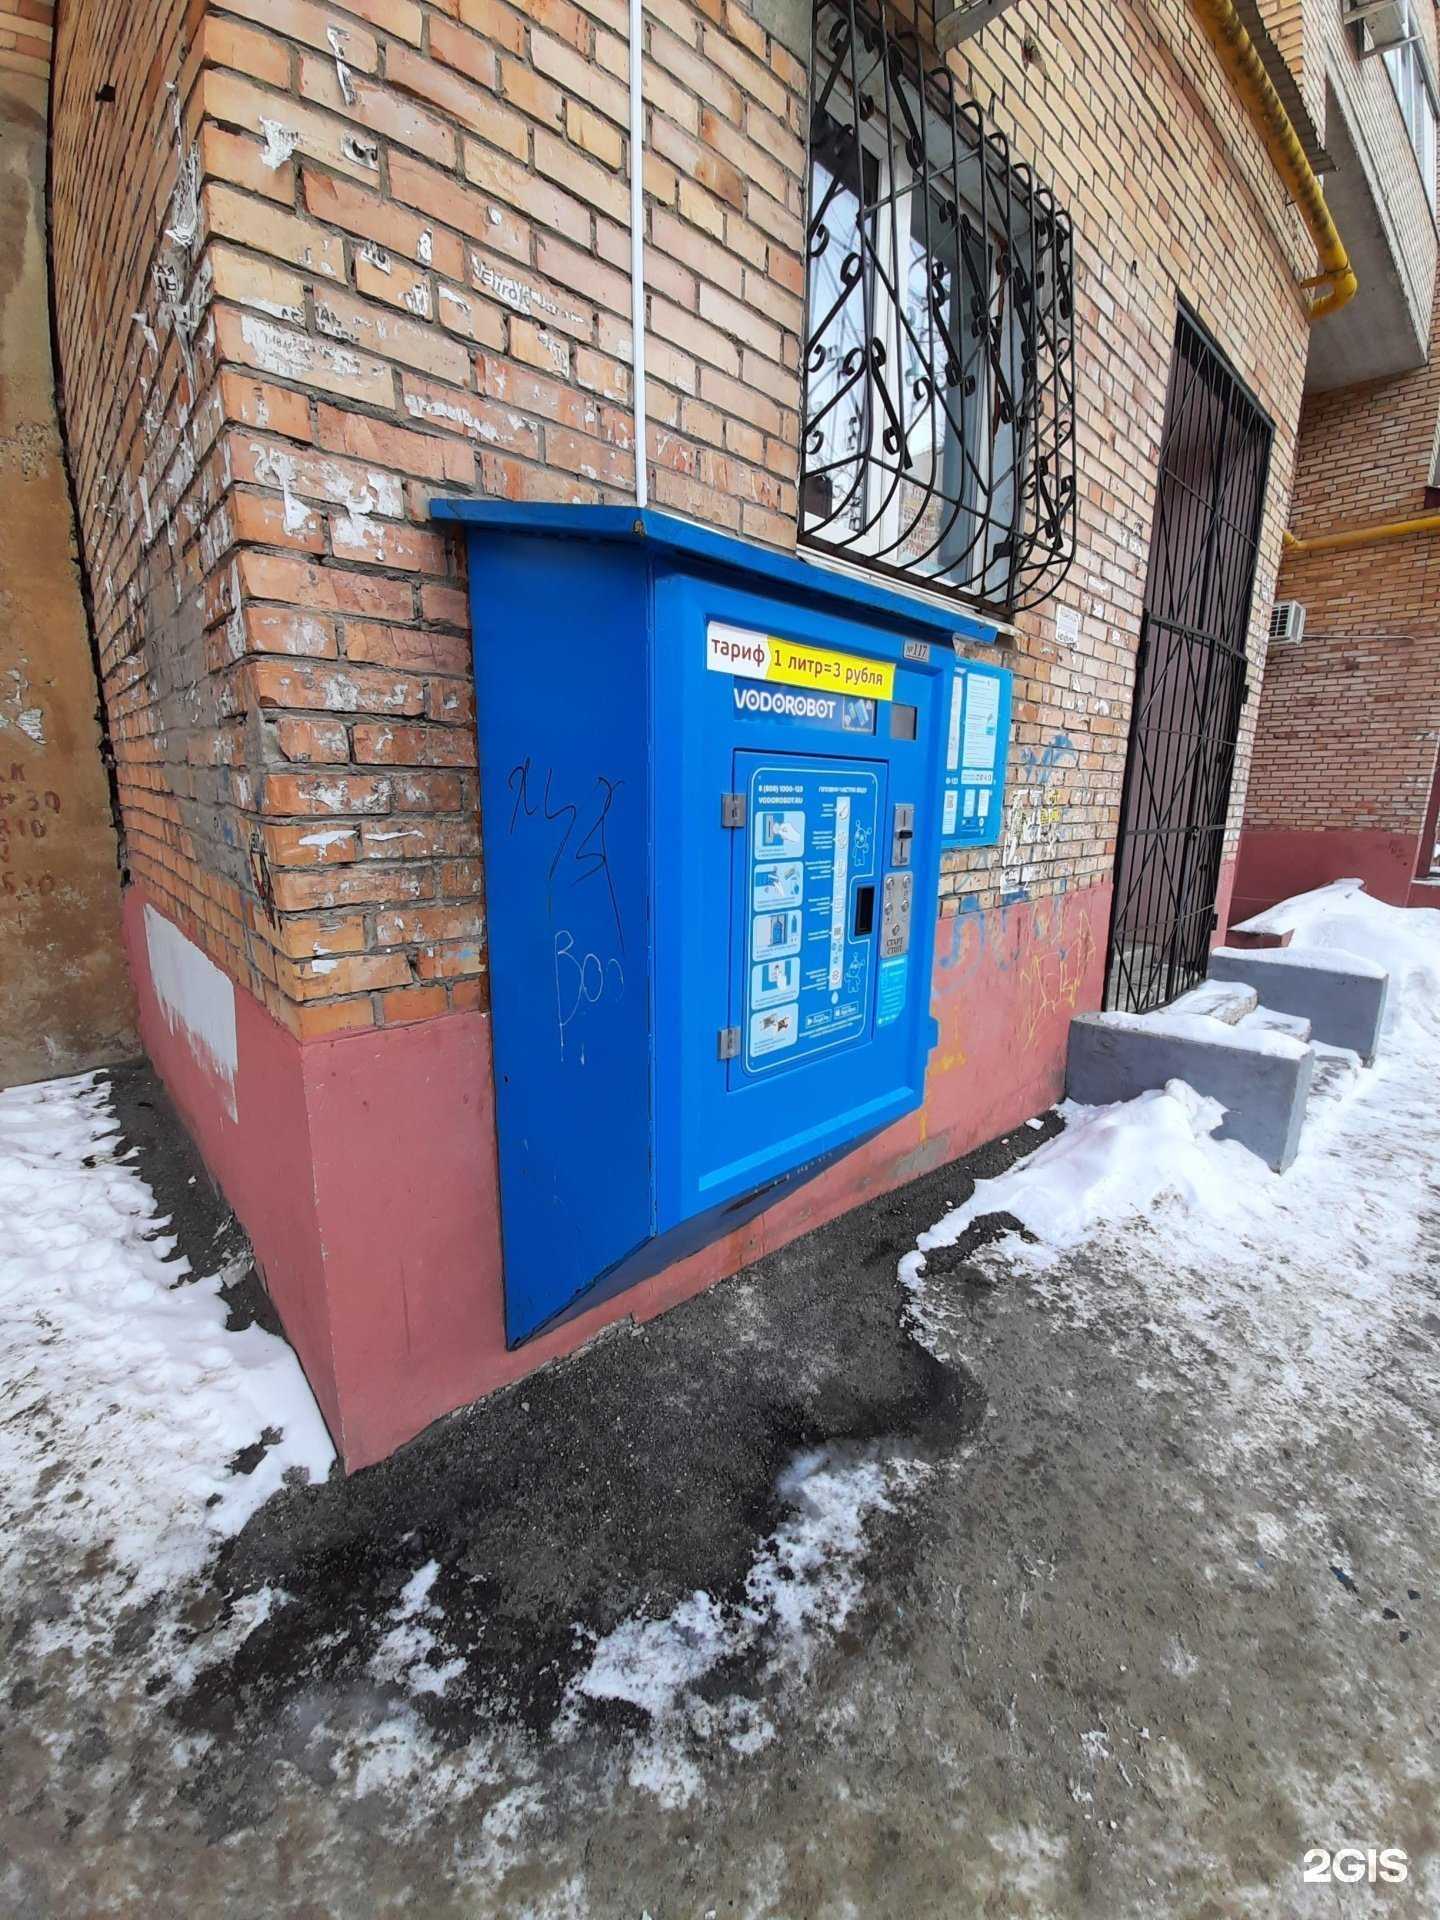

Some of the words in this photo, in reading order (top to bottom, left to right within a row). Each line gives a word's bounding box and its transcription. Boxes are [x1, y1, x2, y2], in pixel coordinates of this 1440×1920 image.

[711, 638, 765, 667] тариф
[774, 650, 782, 667] 1
[788, 655, 841, 678] литр=3
[845, 667, 883, 686] рубля
[733, 688, 836, 719] VODOROBOT
